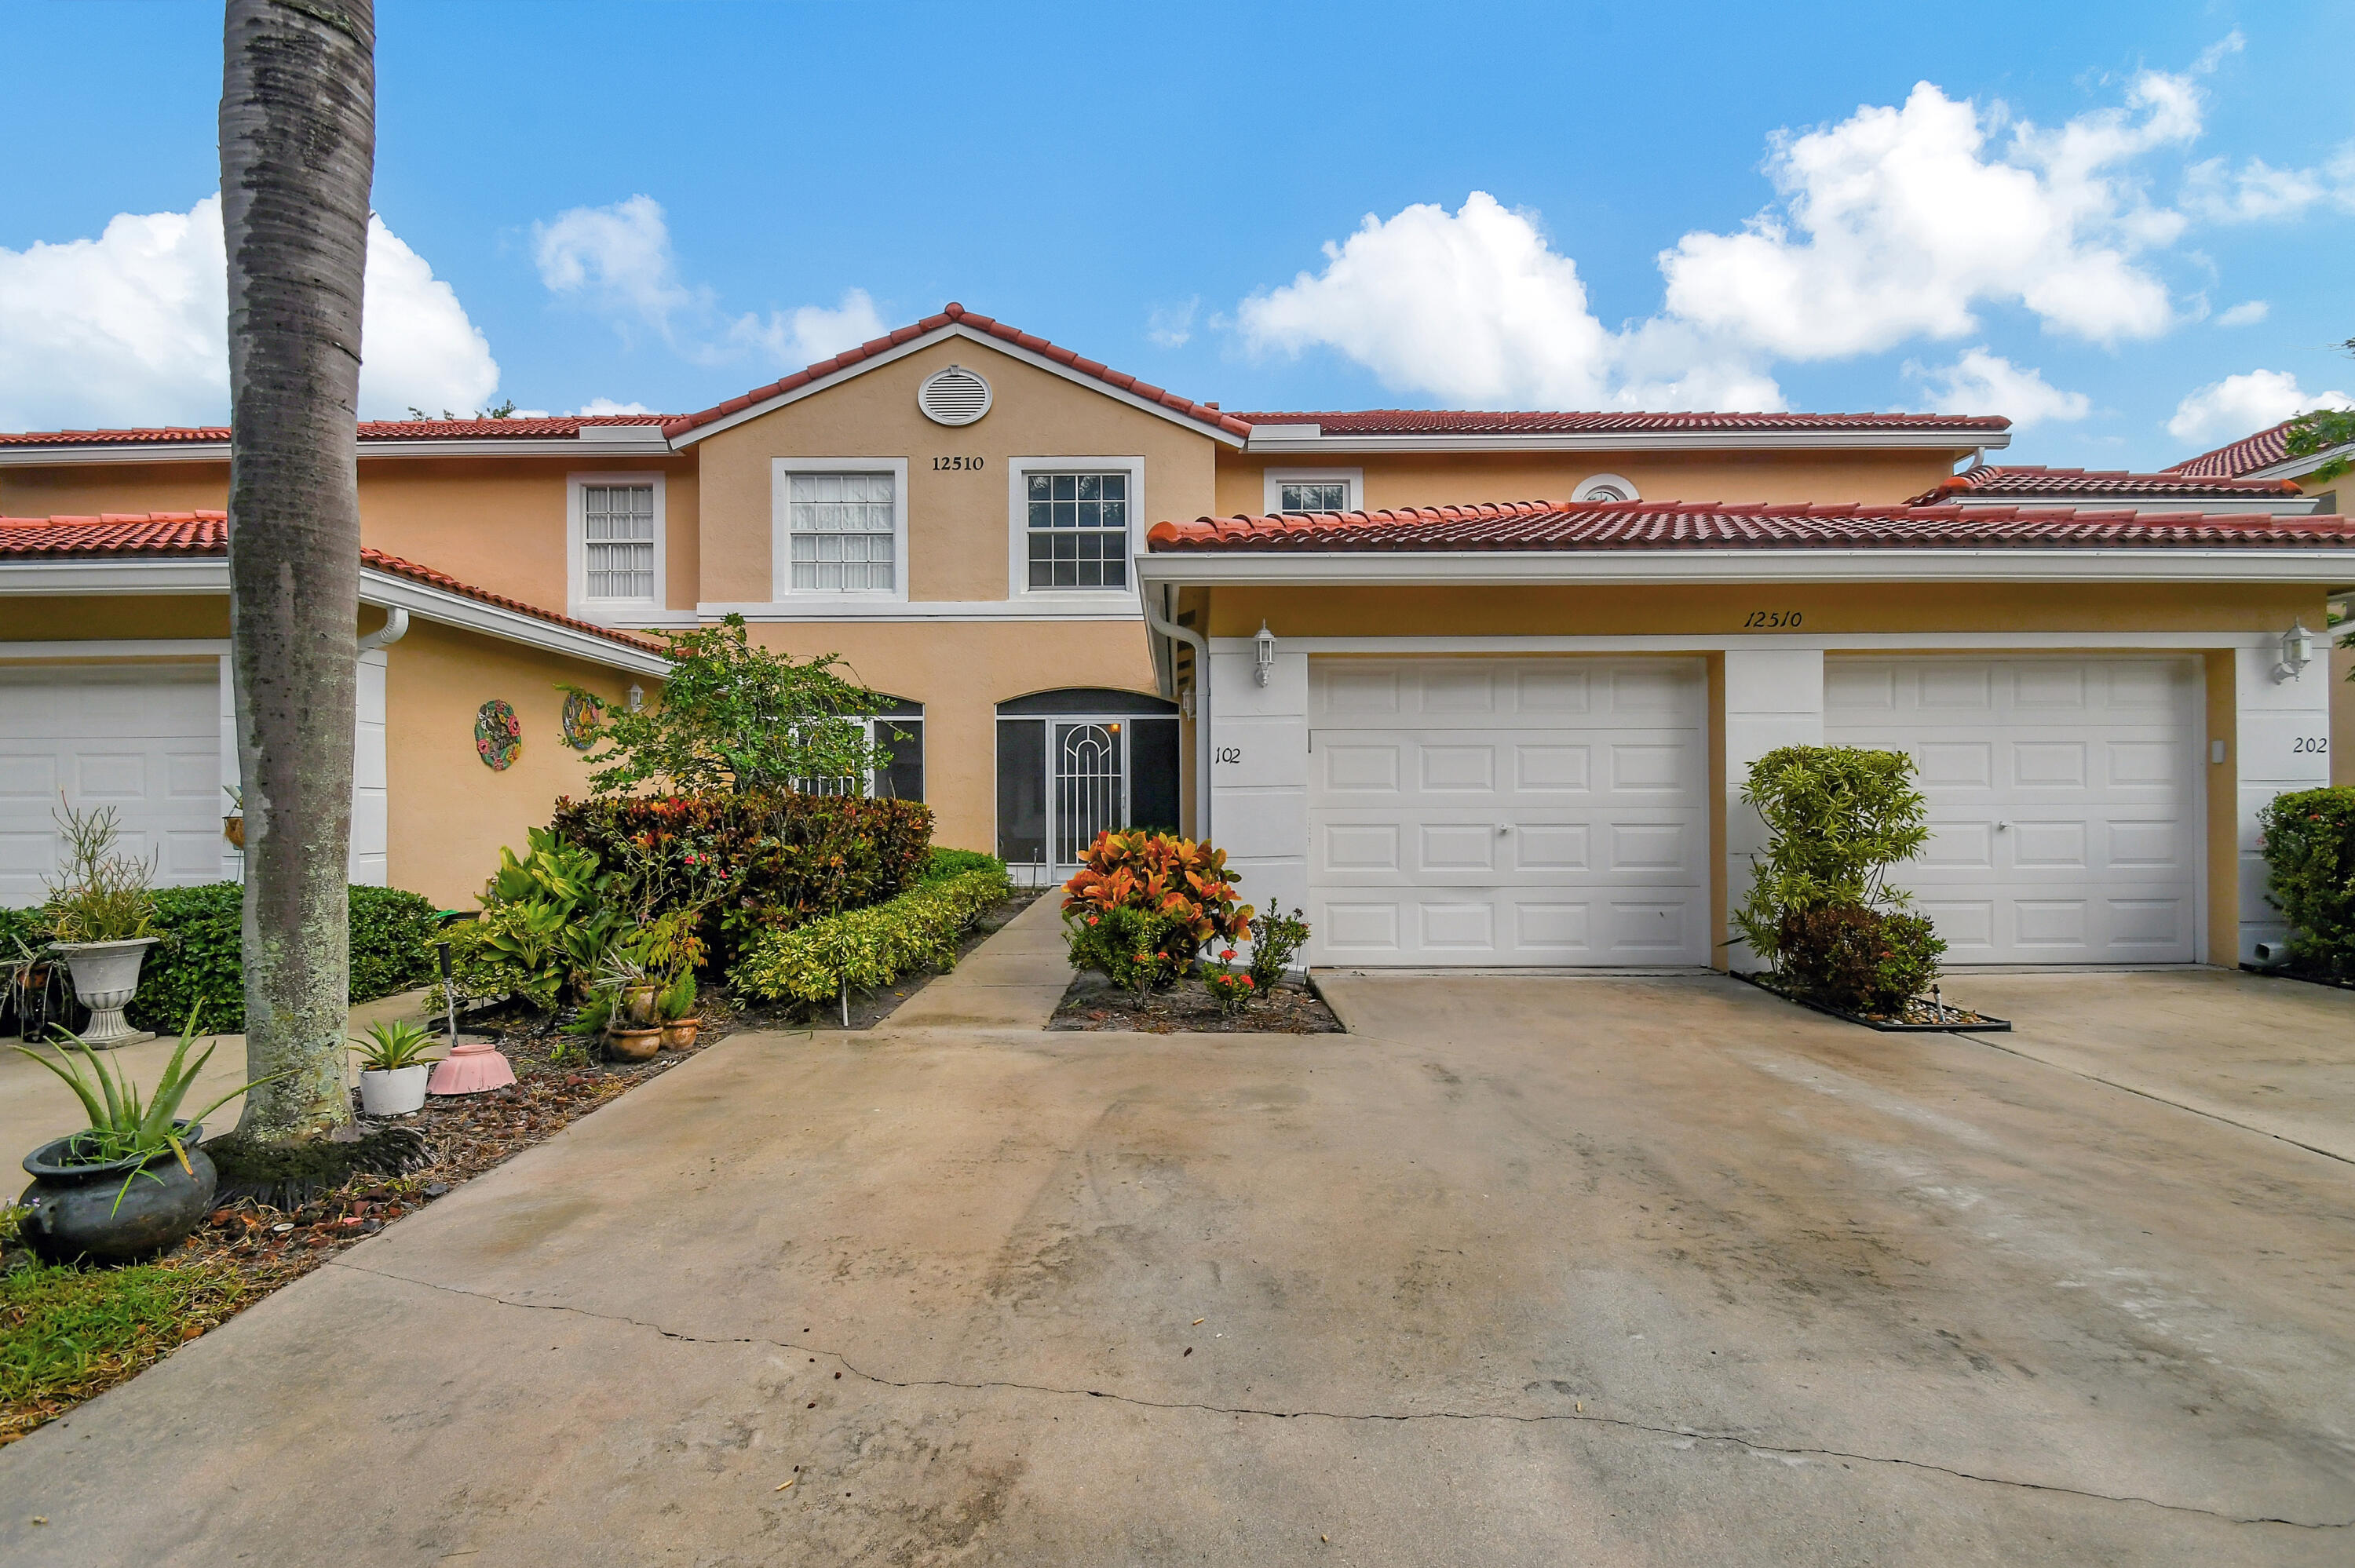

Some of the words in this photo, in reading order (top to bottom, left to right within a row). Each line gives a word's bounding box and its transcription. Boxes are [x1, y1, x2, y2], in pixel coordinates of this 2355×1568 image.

[933, 456, 984, 471] 12510
[1743, 611, 1802, 627] 12510
[2293, 737, 2328, 753] 202
[1215, 746, 1241, 764] 102
